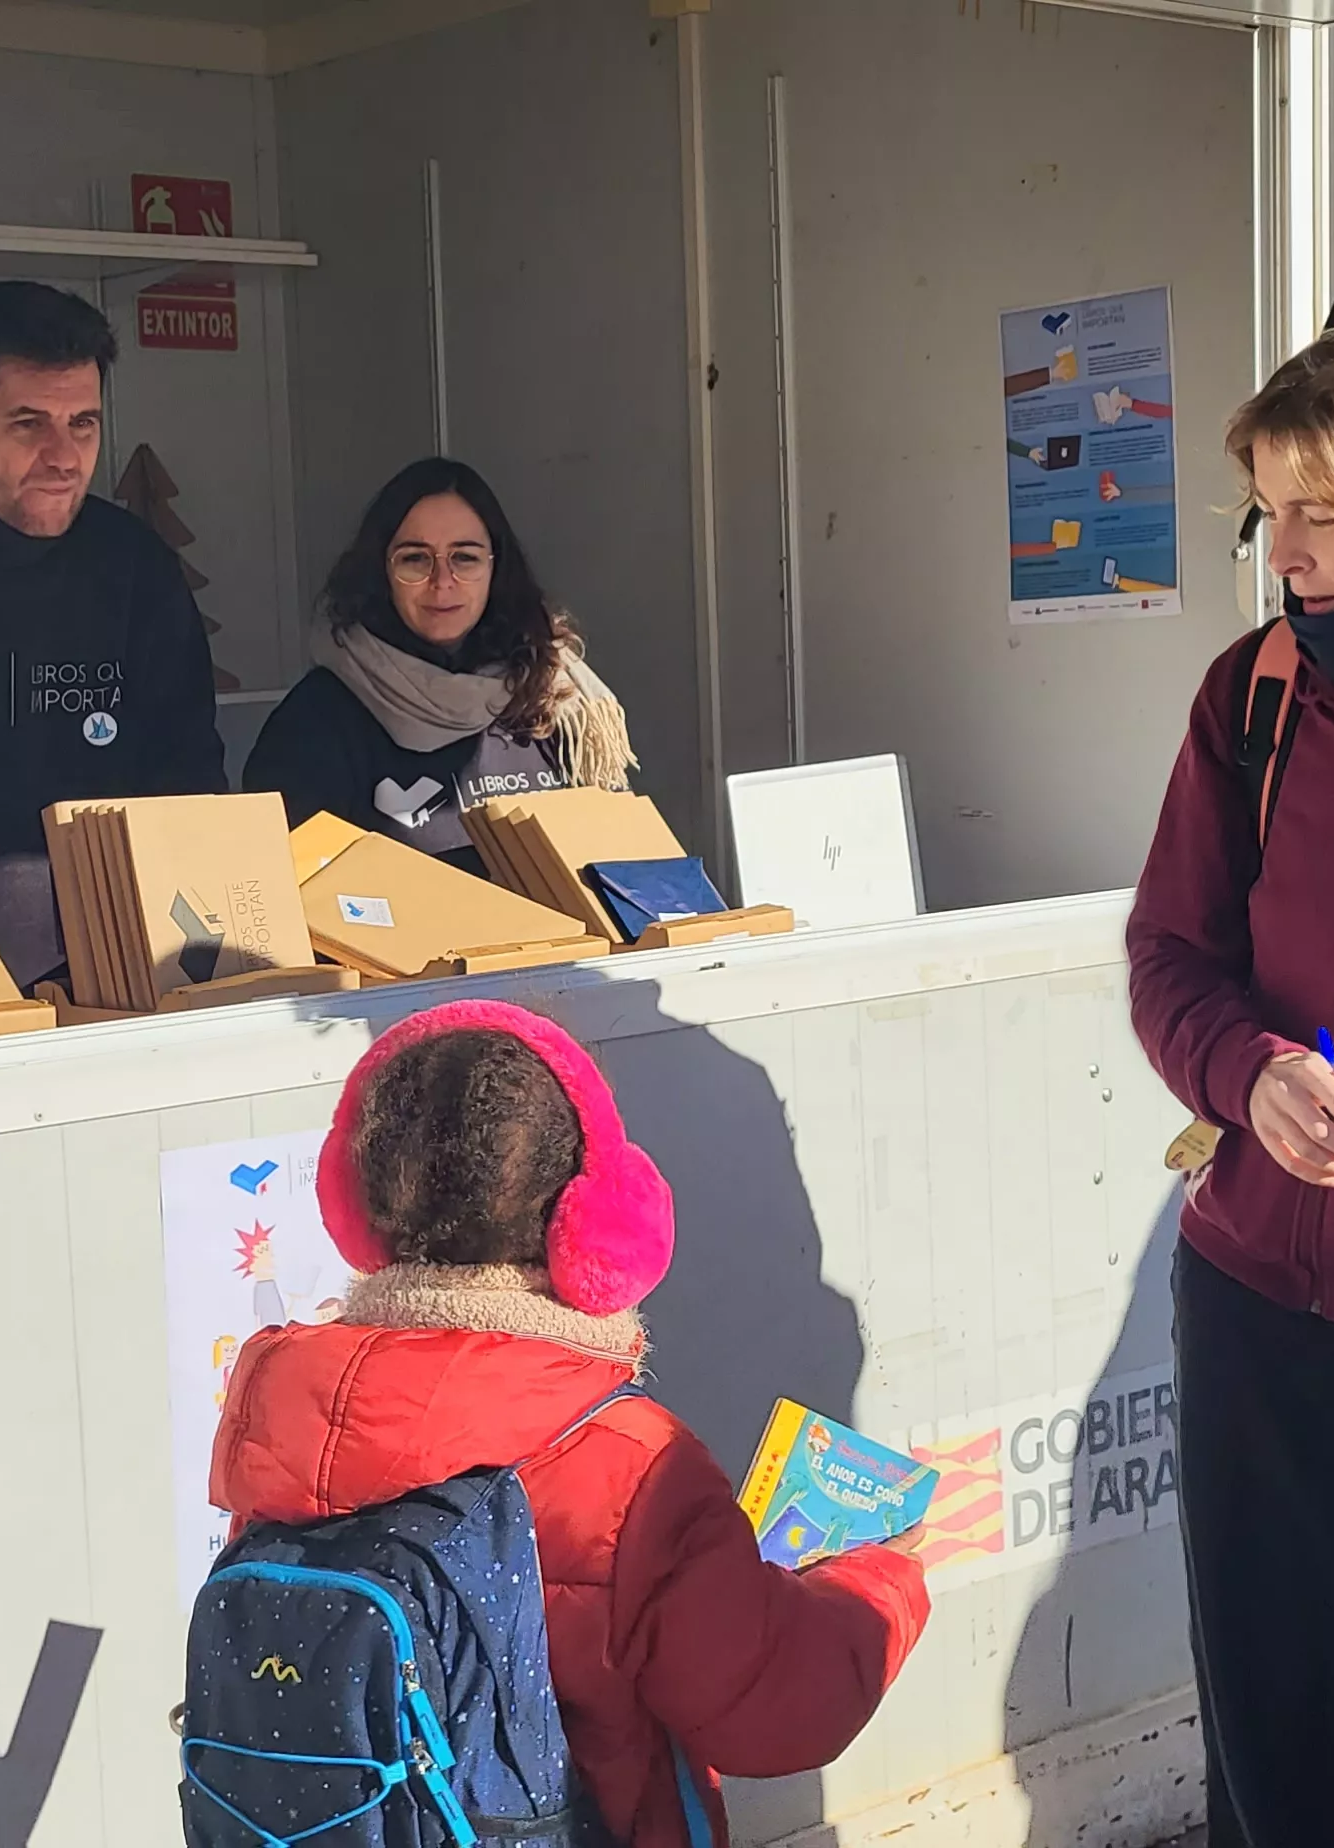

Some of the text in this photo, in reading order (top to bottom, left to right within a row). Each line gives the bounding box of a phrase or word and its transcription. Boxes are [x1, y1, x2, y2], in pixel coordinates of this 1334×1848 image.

[142, 308, 234, 339] EXTINTOR
[468, 771, 530, 797] LIBROS
[231, 881, 248, 915] QUE
[811, 1454, 824, 1471] EL
[825, 1462, 857, 1486] AMOR
[857, 1475, 874, 1493] ES
[874, 1484, 905, 1508] COMO
[826, 1479, 839, 1496] EL
[1012, 1448, 1178, 1548] DE ARA
